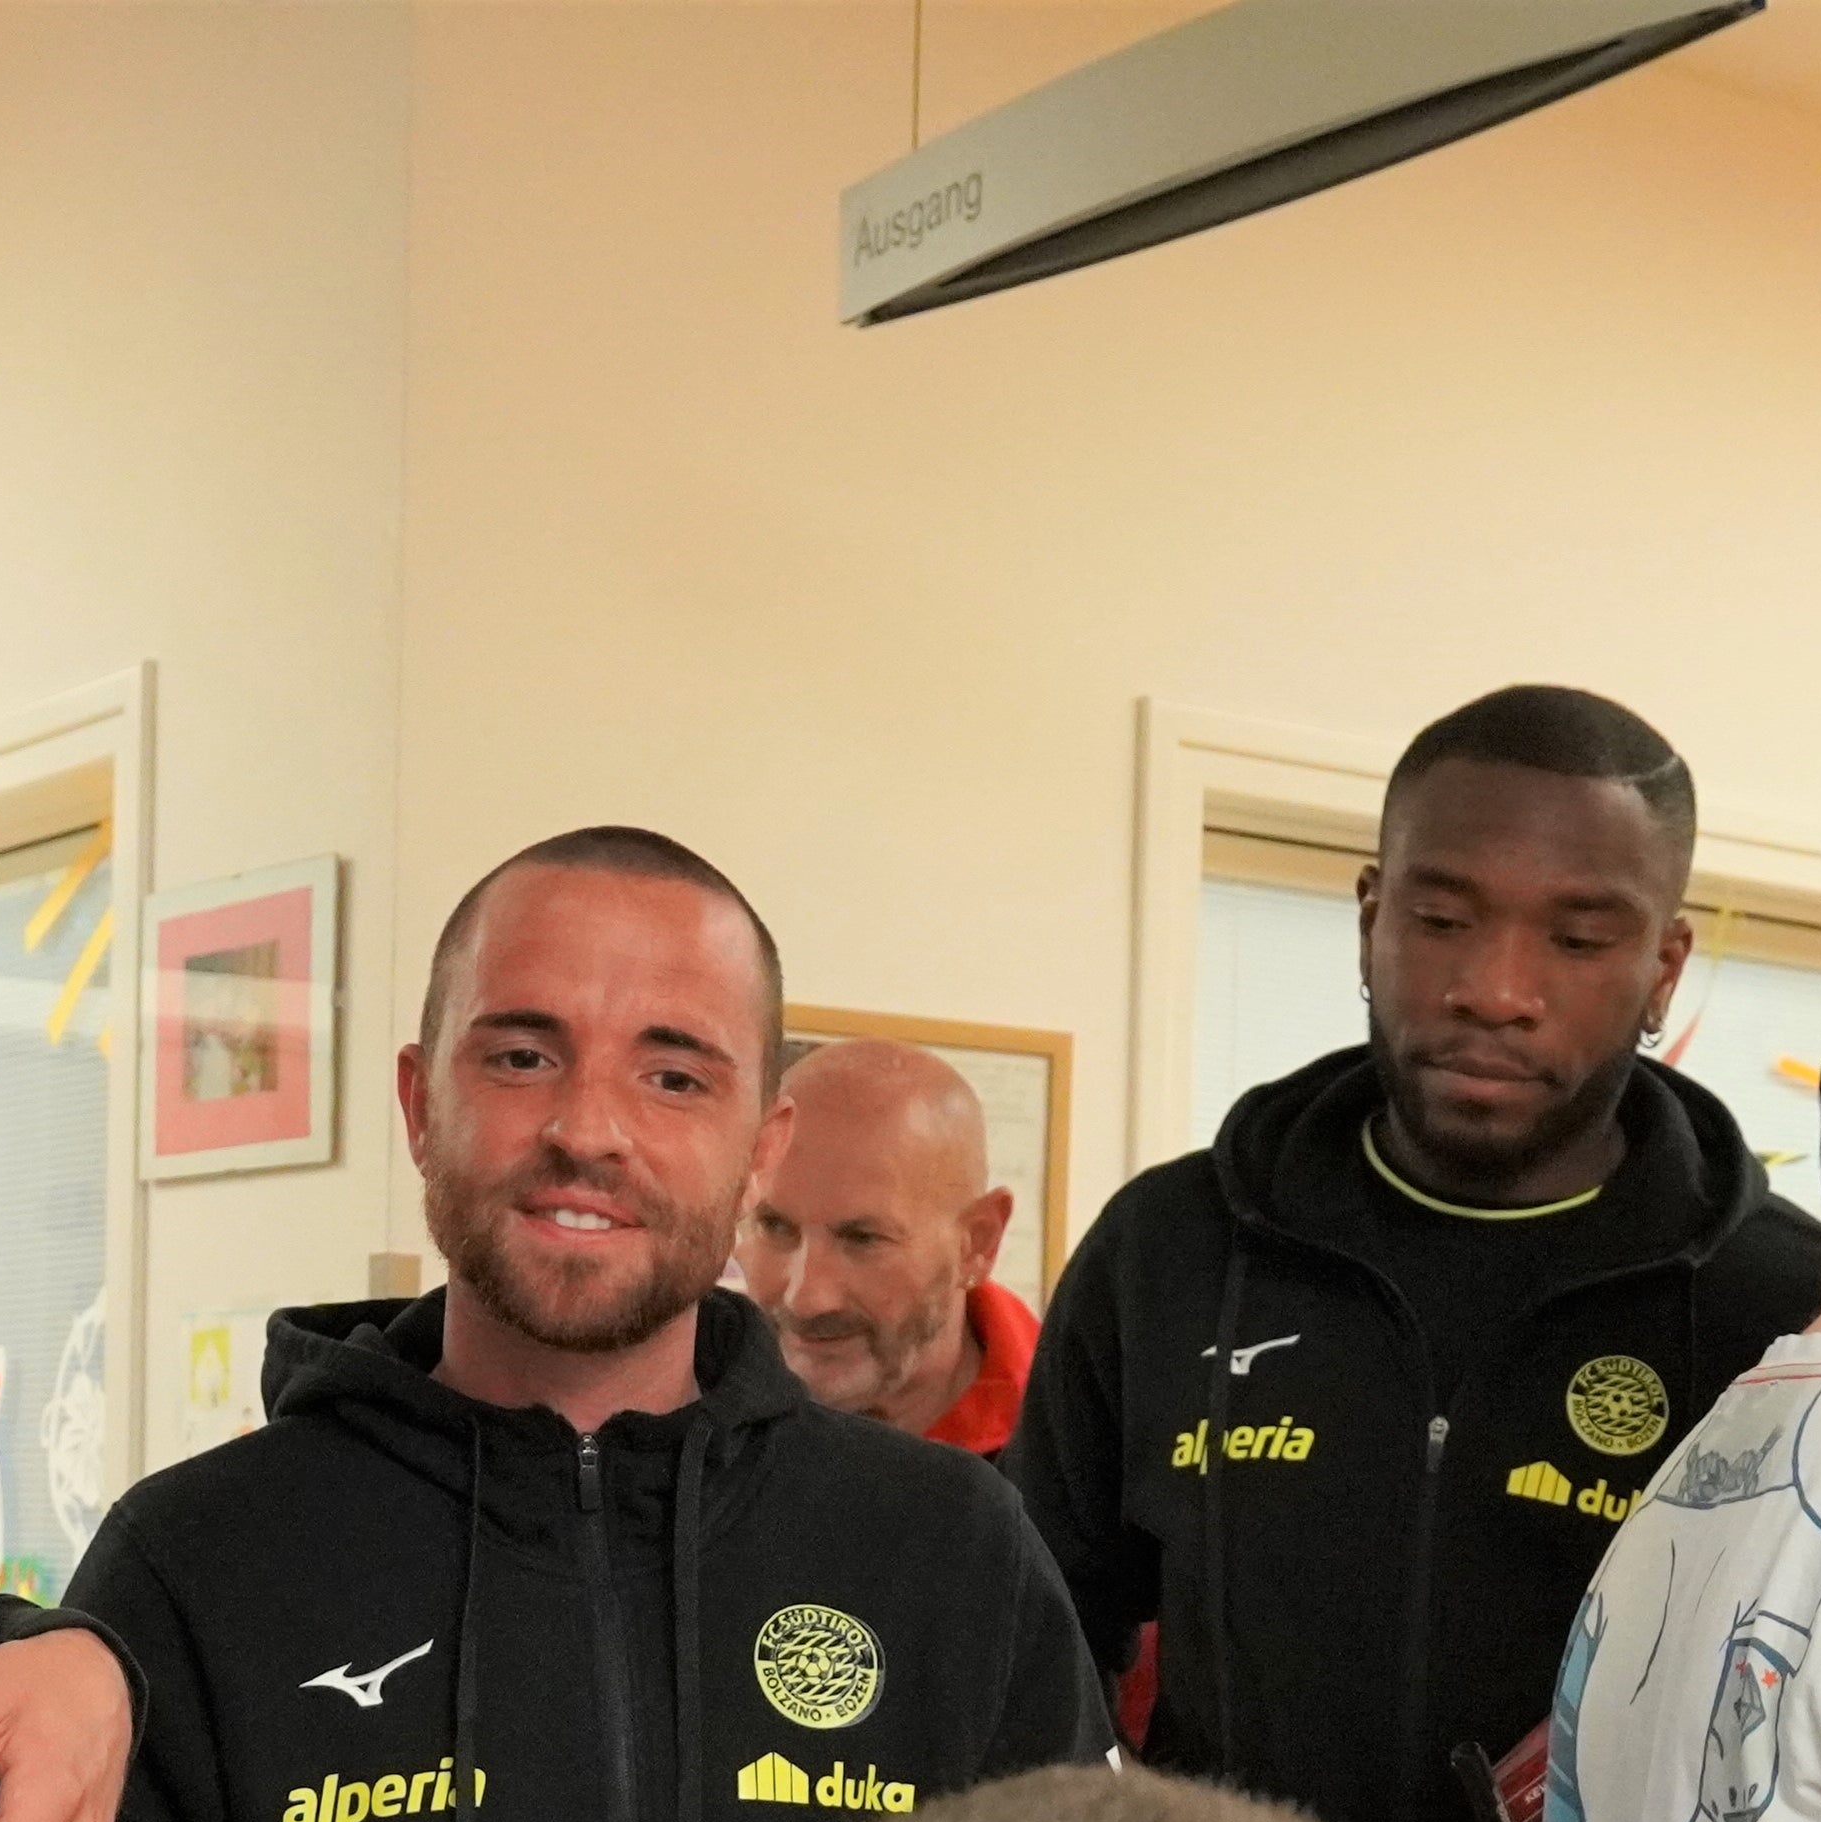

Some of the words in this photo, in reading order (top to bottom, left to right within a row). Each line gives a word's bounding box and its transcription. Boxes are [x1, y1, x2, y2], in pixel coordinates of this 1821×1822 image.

[852, 172, 983, 271] Ausgang
[777, 1607, 869, 1657] SÜDTIROL
[762, 1666, 823, 1723] BOLZANO
[834, 1671, 872, 1718] BOZEN
[815, 1761, 916, 1813] duka
